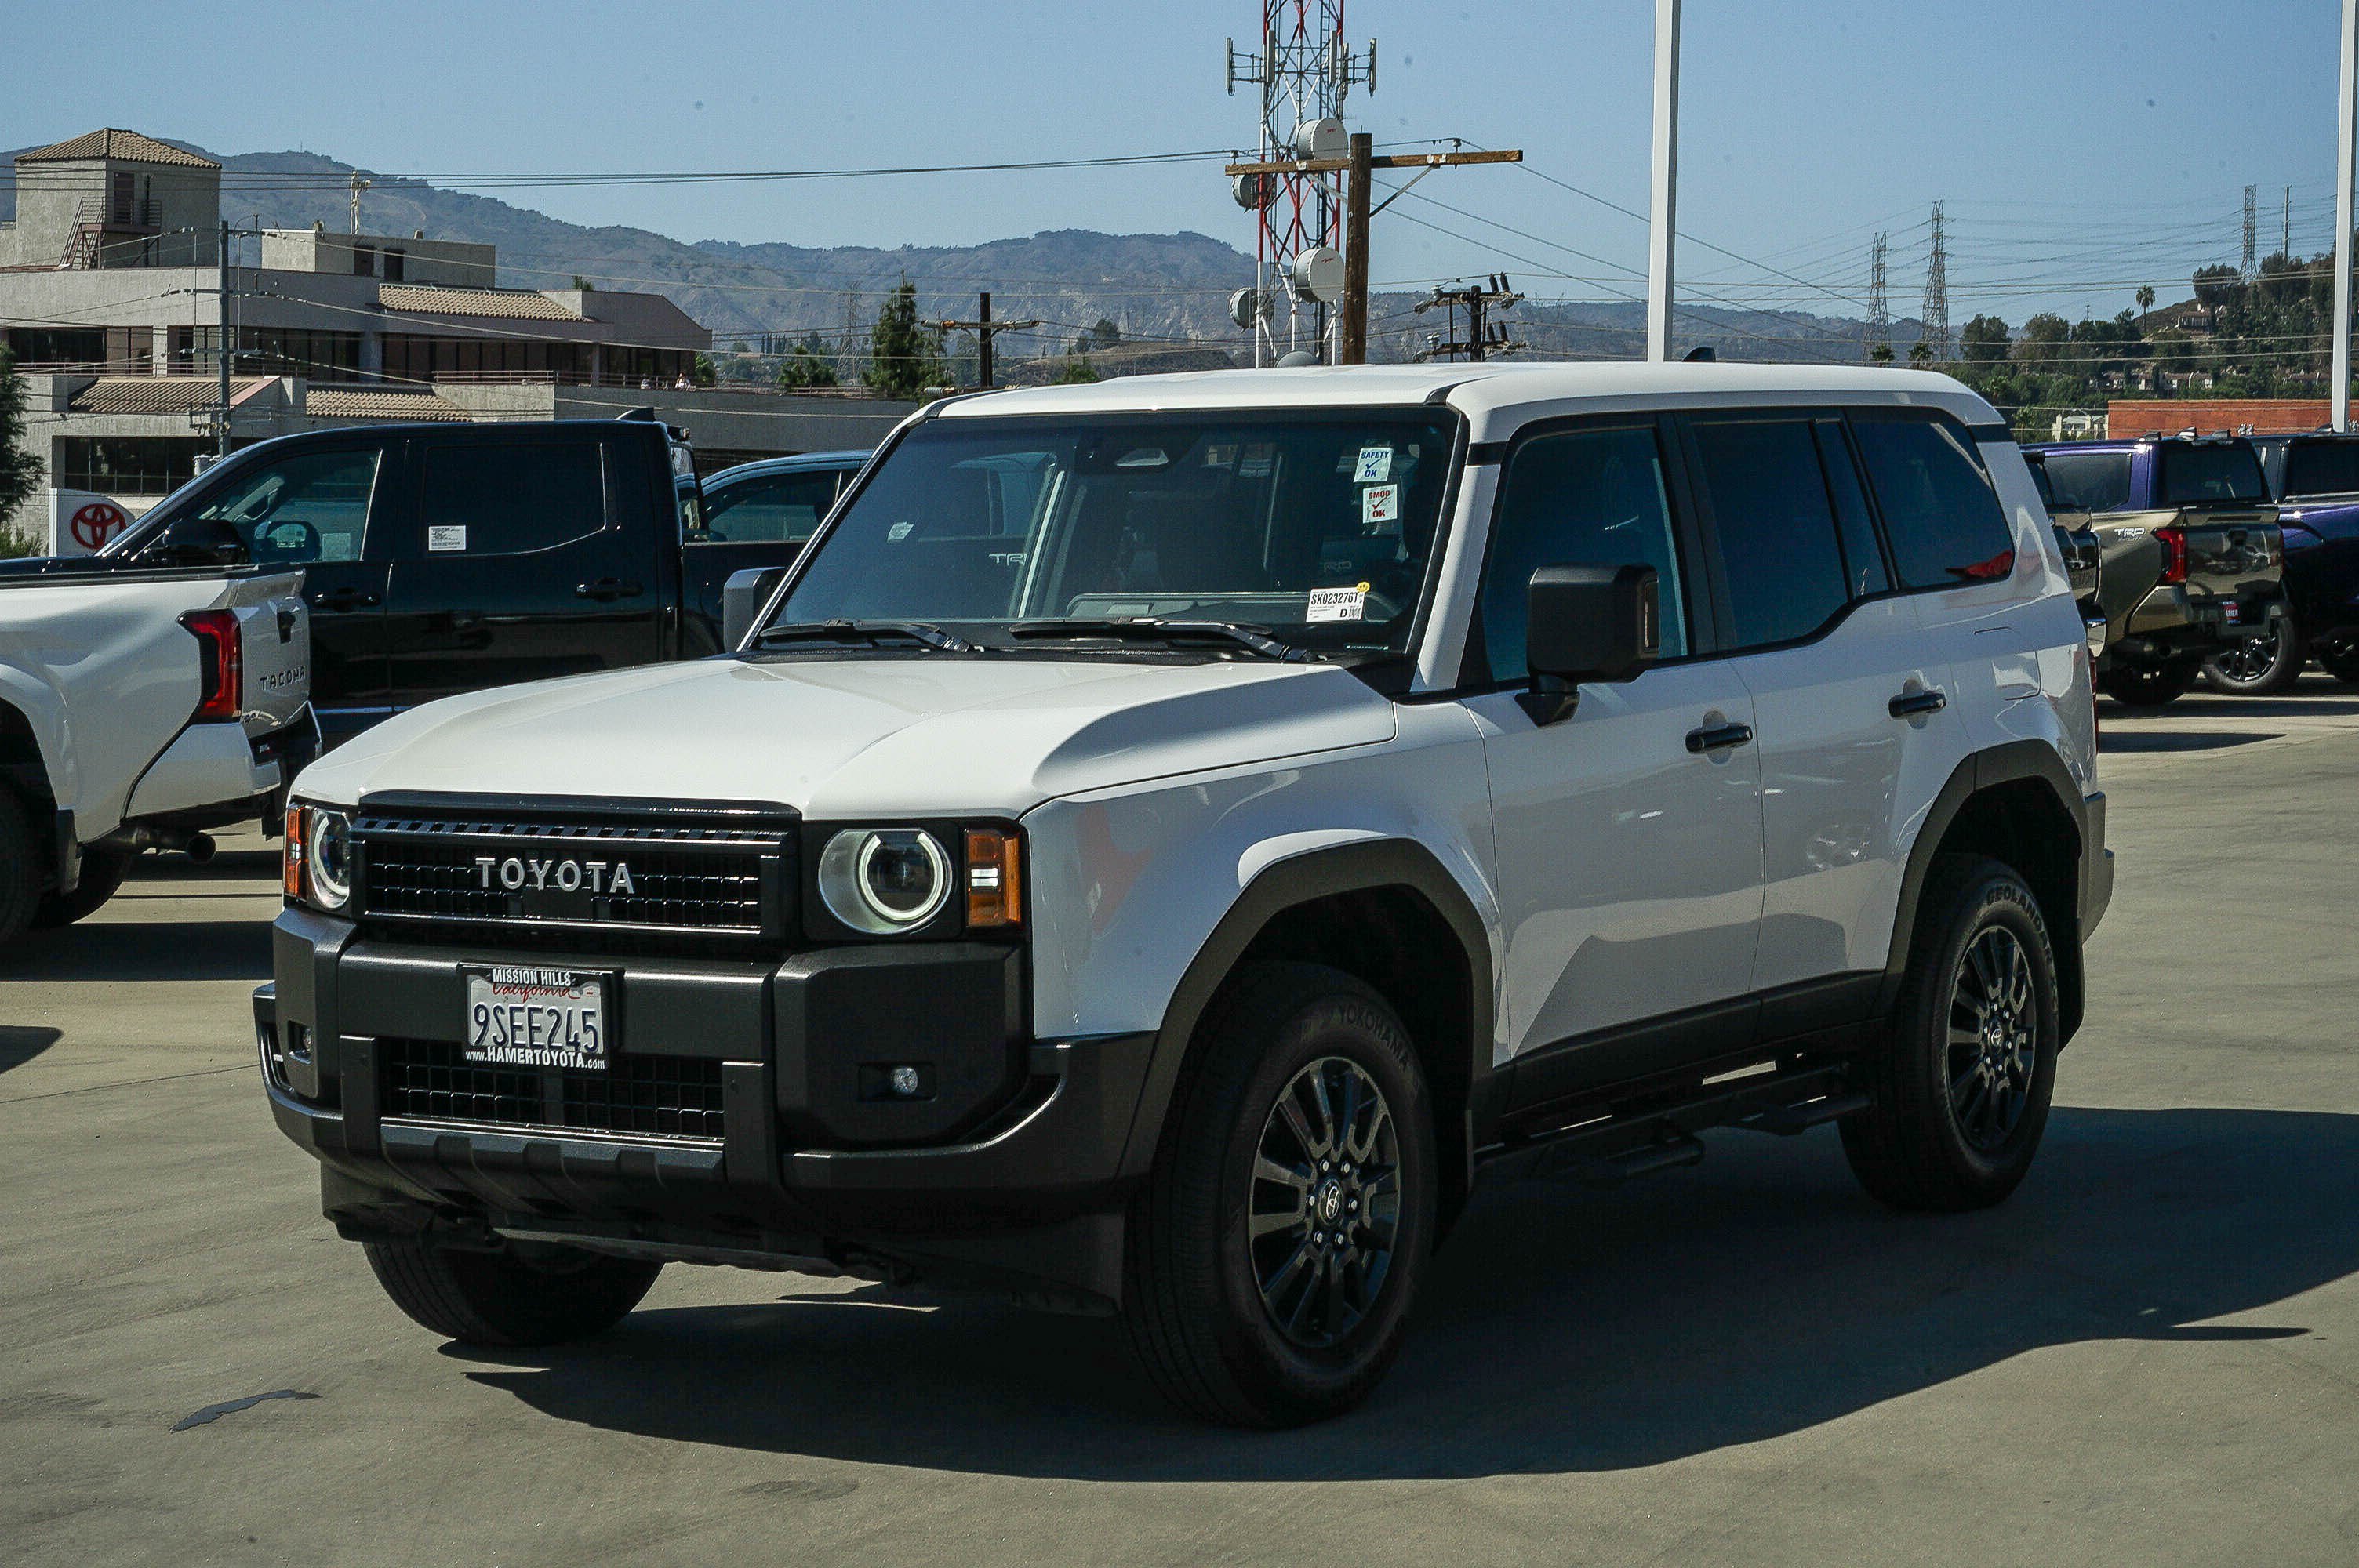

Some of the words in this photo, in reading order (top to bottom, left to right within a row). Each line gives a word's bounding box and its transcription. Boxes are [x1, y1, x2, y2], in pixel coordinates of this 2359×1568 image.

[1361, 451, 1390, 459] SAFETY
[1372, 509, 1386, 518] OK
[2114, 527, 2146, 538] TRD
[260, 666, 306, 691] TACOMA
[474, 857, 635, 895] TOYOTA
[492, 968, 538, 985] MISSION
[540, 970, 572, 986] HILLS
[492, 982, 580, 1004] California
[473, 1002, 599, 1053] 9SEE245
[1338, 1004, 1409, 1073] YOKOHAMA
[465, 1046, 605, 1069] www.HAMERTOYOTA.com
